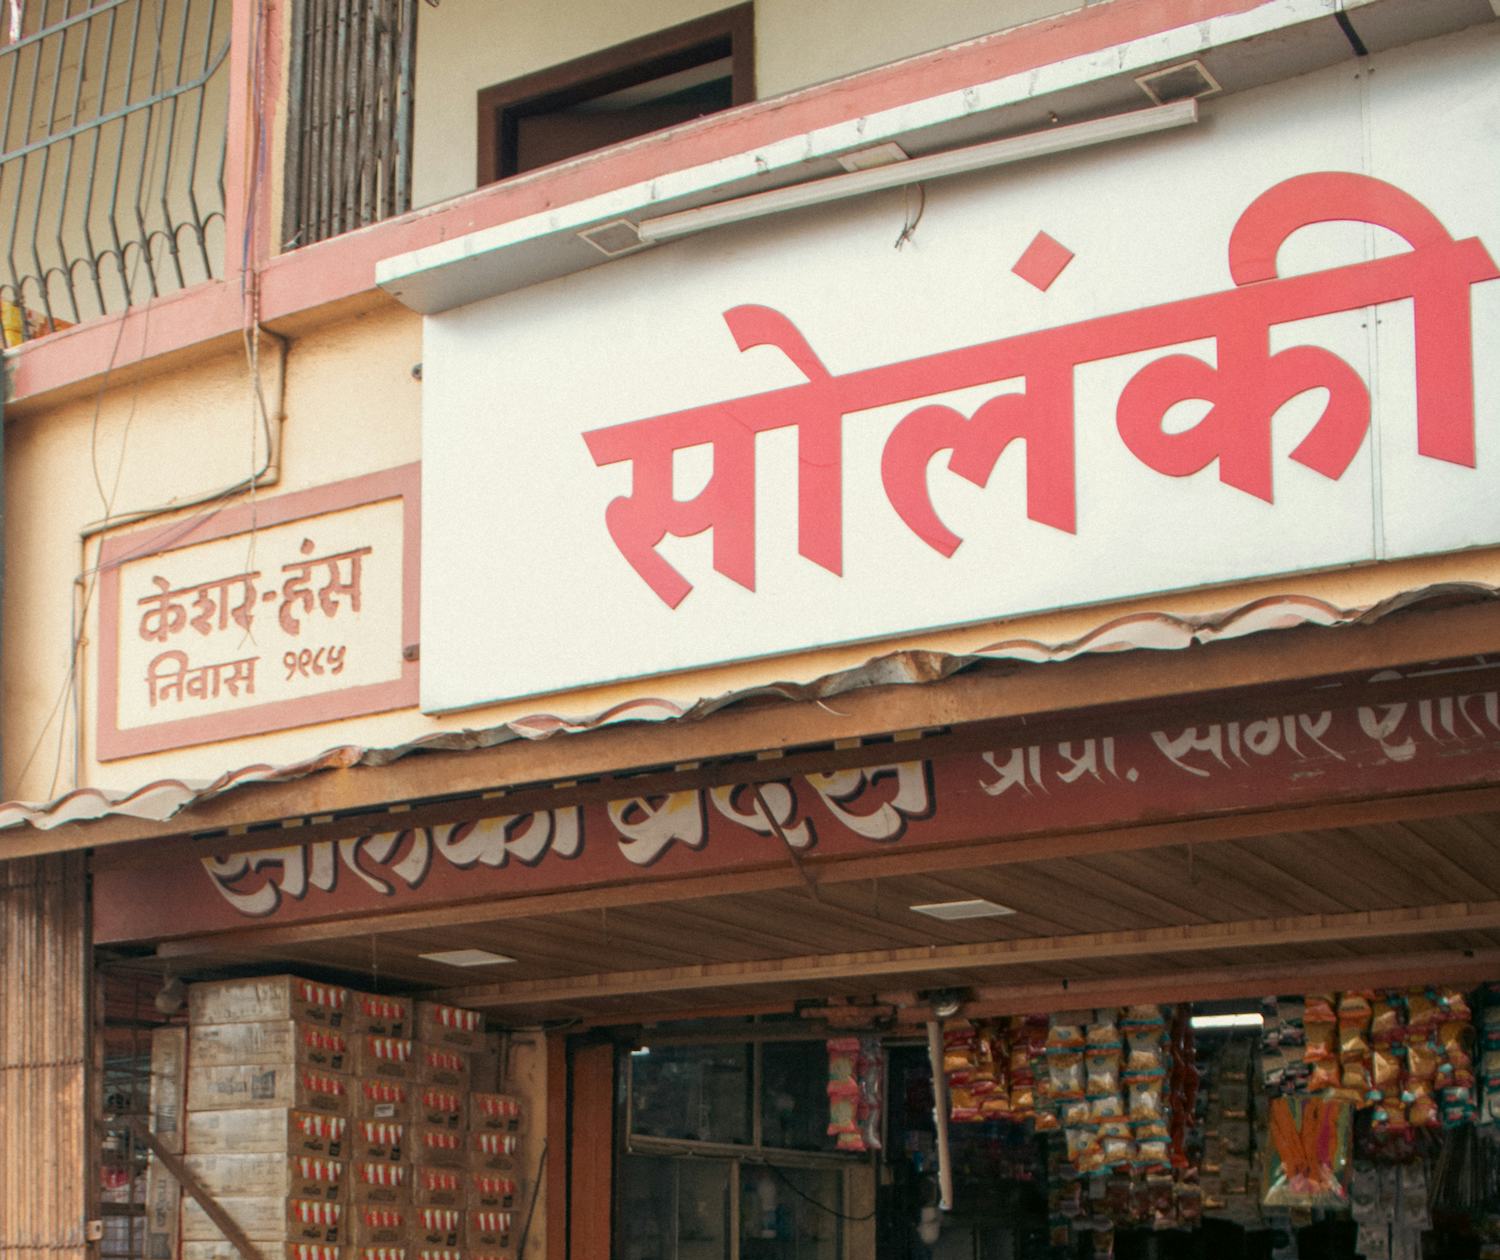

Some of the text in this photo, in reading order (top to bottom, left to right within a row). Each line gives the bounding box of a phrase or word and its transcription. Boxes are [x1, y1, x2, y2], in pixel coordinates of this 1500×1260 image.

[582, 171, 1500, 609] सोलंकी
[137, 538, 373, 642] केशर-हंस
[144, 645, 346, 707] निवास १९८५
